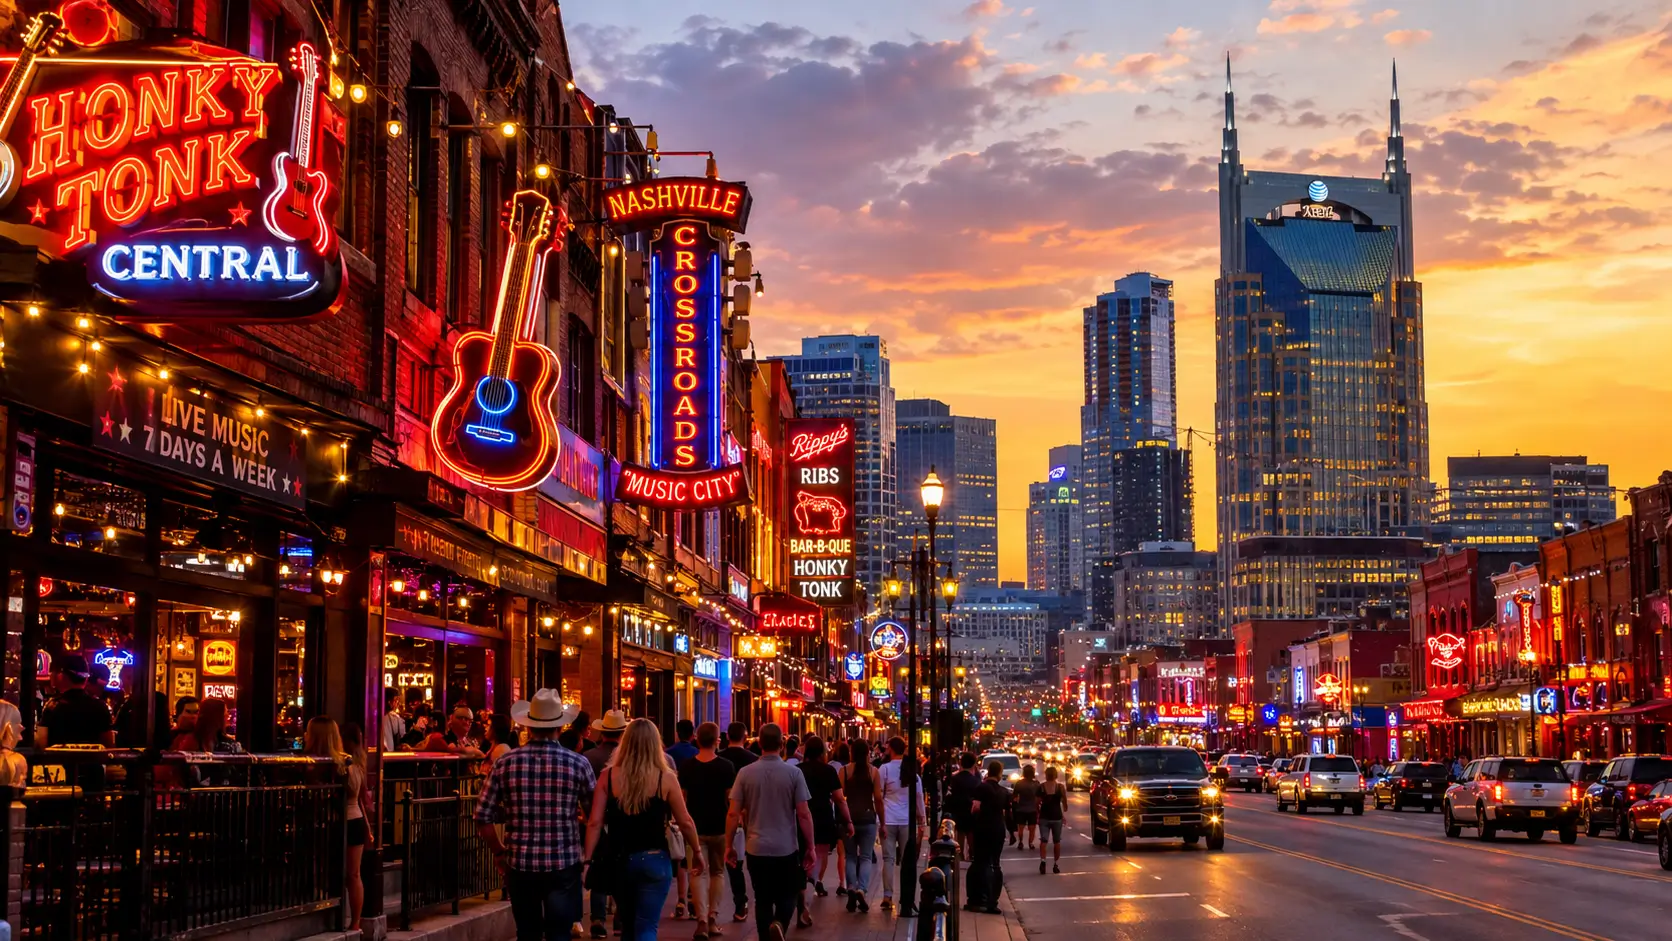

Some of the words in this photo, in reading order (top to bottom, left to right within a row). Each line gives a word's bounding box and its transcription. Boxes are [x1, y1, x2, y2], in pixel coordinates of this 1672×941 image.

[25, 64, 279, 181] HONKY
[55, 130, 253, 251] TONK
[608, 184, 740, 219] NASHVILLE
[101, 243, 311, 282] CENTRAL
[673, 226, 698, 466] CROSSROADS
[161, 389, 206, 435] LIVE
[211, 413, 270, 459] MUSIC
[789, 423, 849, 462] Rippy's
[143, 425, 155, 452] 7
[159, 430, 207, 470] DAYS
[211, 449, 225, 476] A
[231, 454, 278, 493] WEEK
[800, 467, 840, 485] RIBS
[624, 469, 687, 501] "MUSIC
[692, 470, 741, 500] CITY"
[789, 538, 851, 554] BAR-B-QUE
[793, 559, 848, 577] HONKY
[799, 581, 842, 598] TONK
